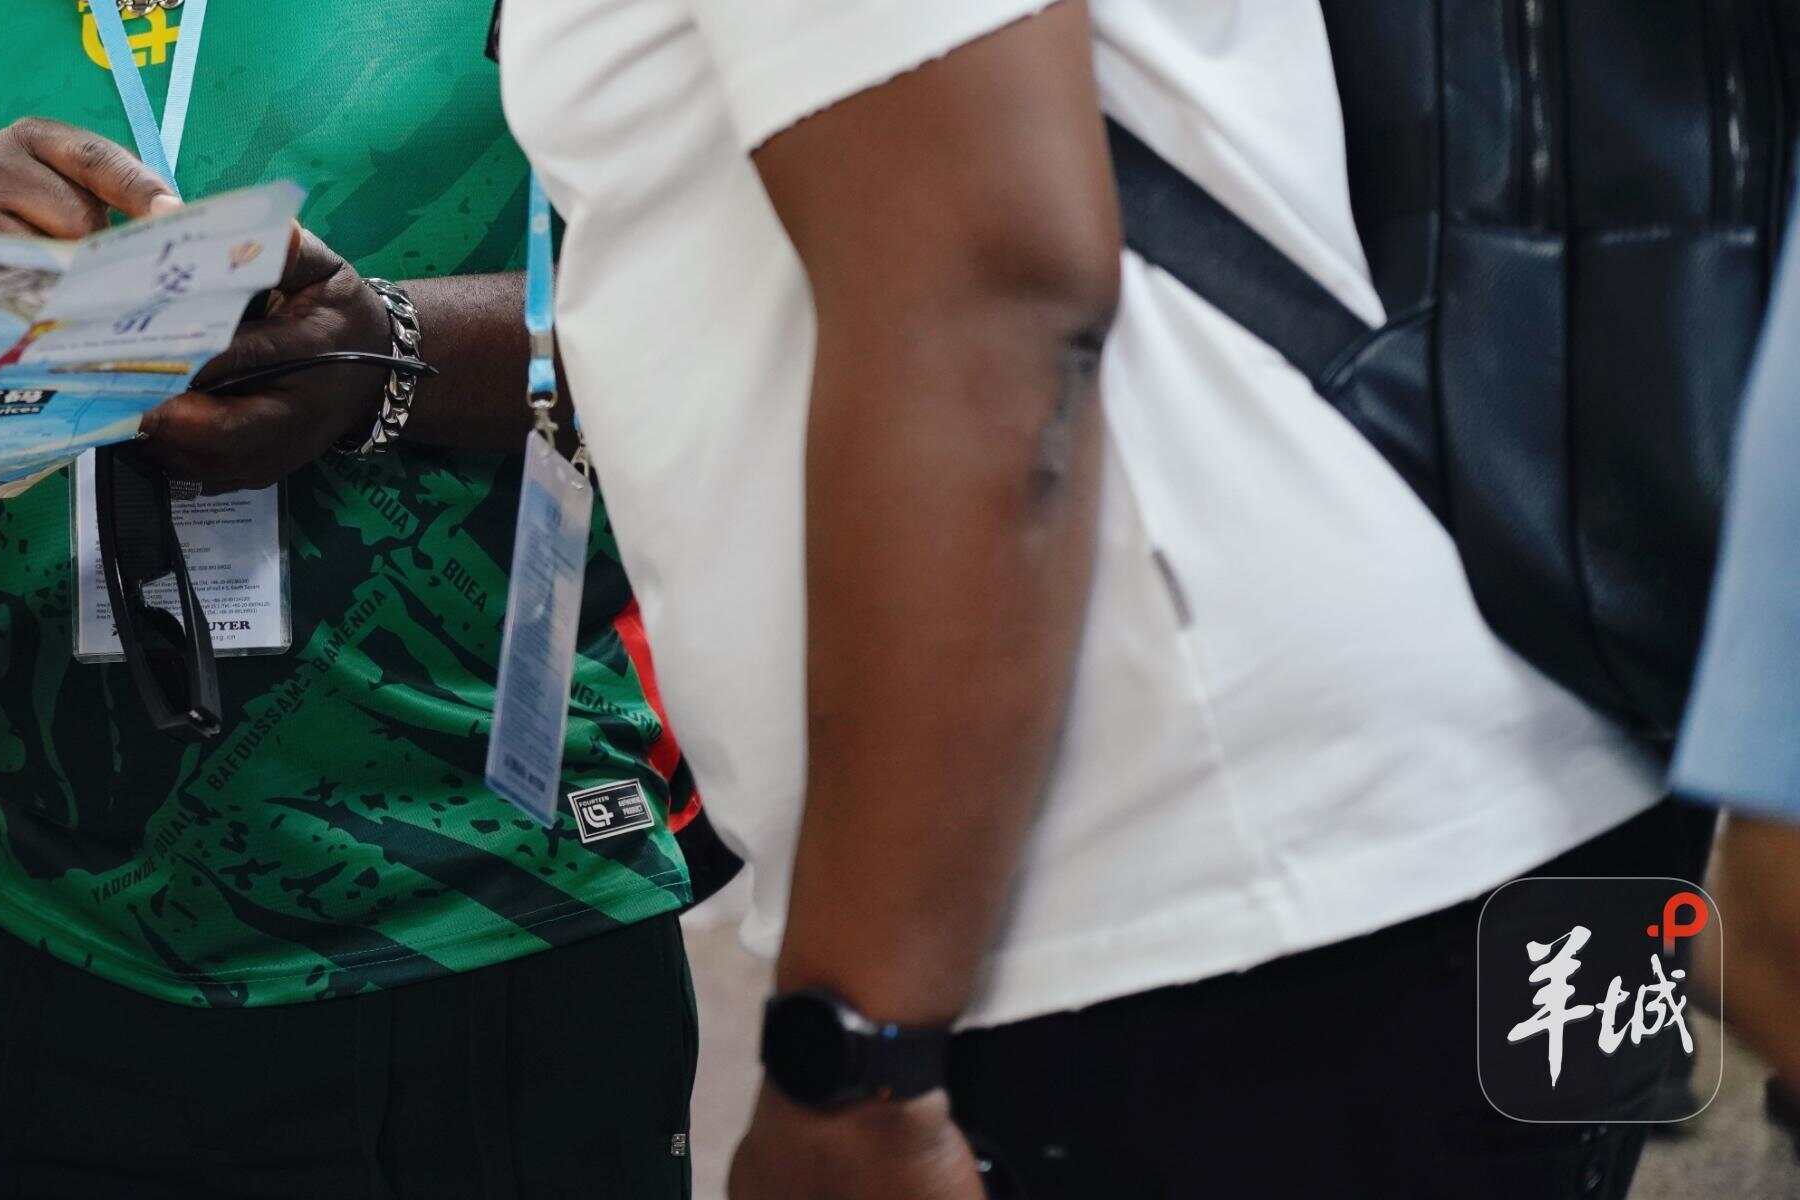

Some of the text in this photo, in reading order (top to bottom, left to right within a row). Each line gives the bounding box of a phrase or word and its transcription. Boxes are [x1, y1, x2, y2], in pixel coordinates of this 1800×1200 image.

[441, 557, 488, 612] BUEA
[208, 620, 251, 631] UYER
[313, 589, 387, 674] BAMENDA
[578, 795, 610, 807] FOURTEEN
